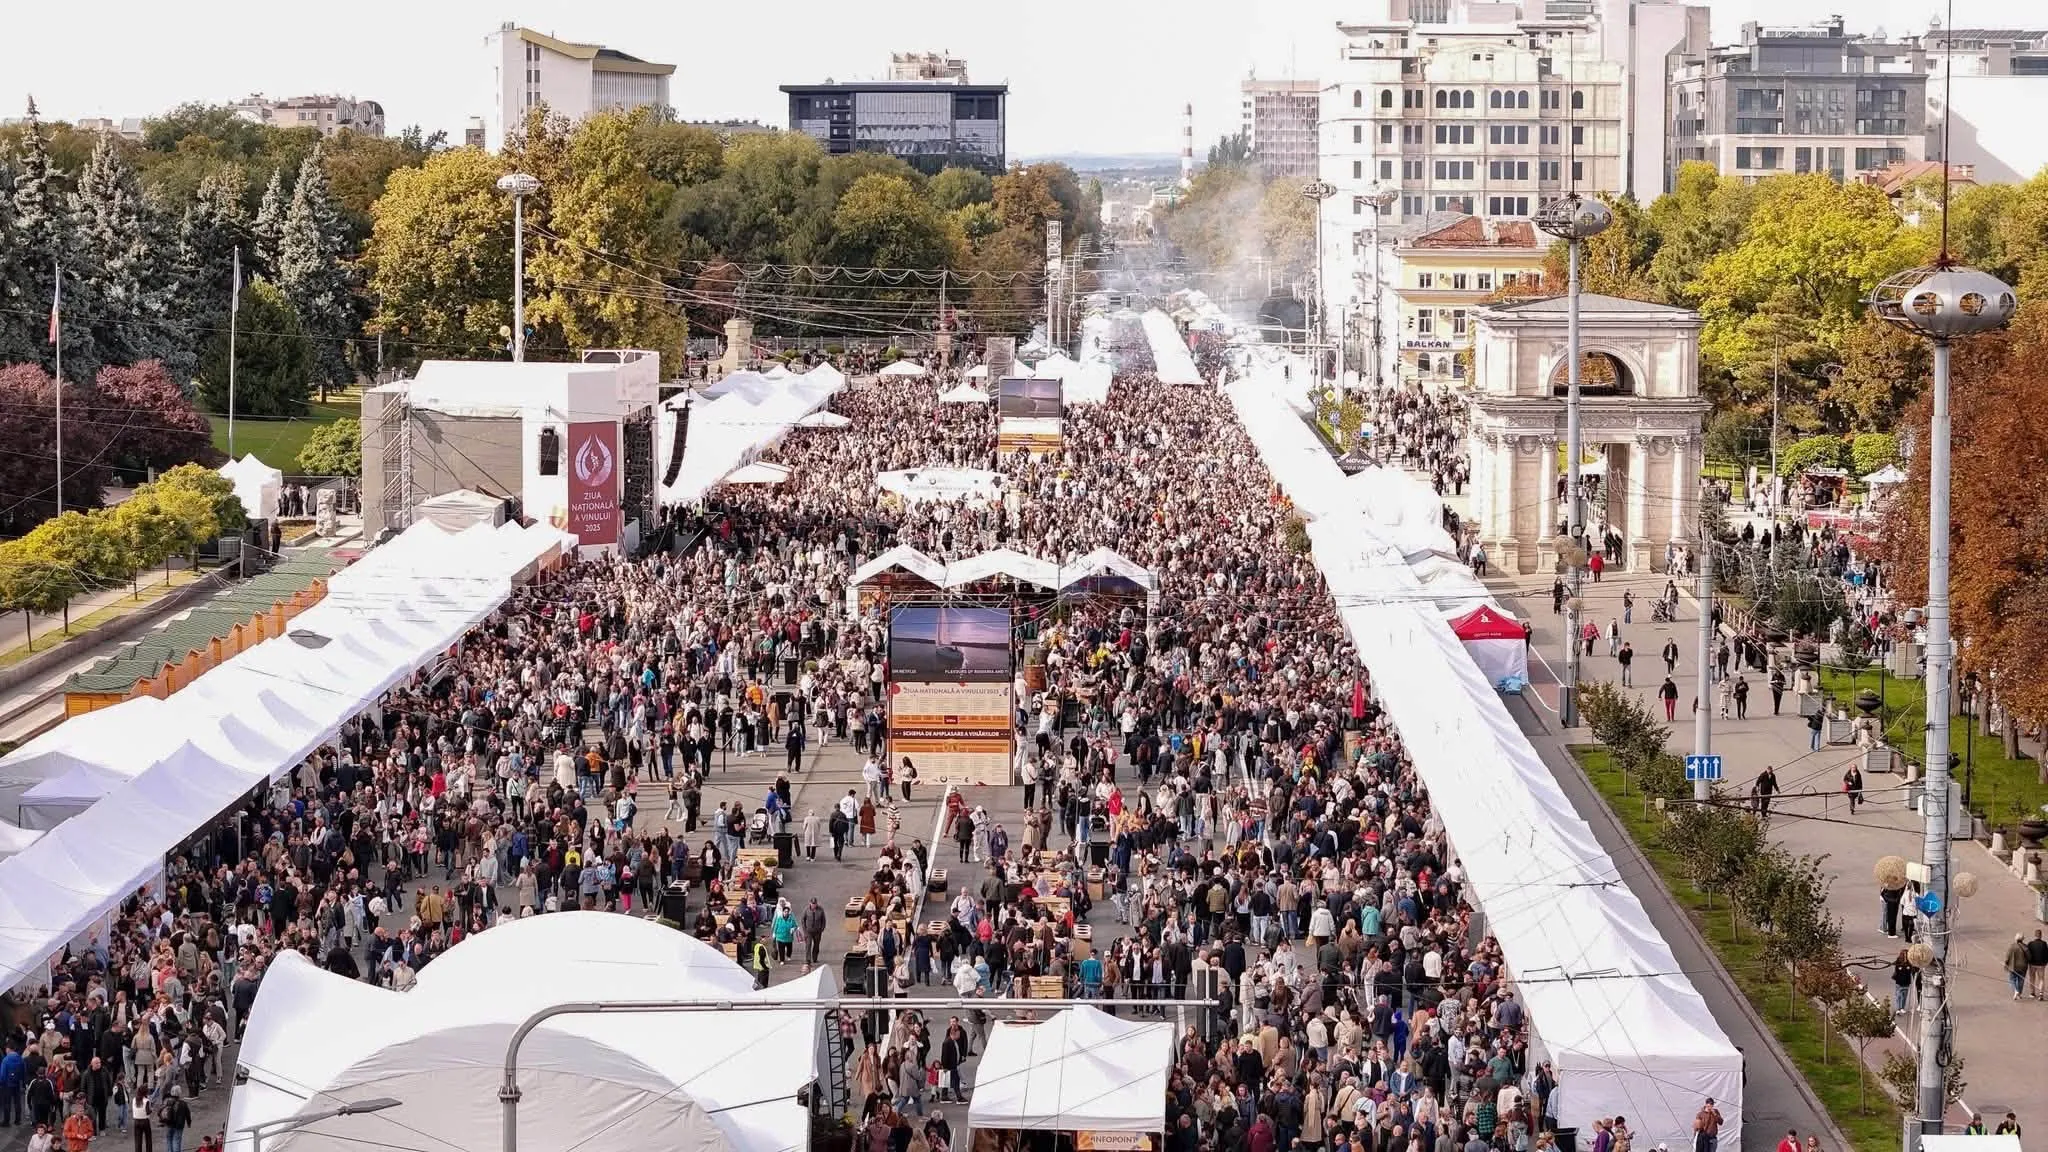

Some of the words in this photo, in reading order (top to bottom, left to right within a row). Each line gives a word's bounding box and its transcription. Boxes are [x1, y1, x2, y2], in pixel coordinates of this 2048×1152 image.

[1406, 340, 1450, 348] BALKAN
[584, 491, 602, 500] ZIUA
[581, 512, 611, 521] VINULUI
[584, 524, 601, 532] 2025
